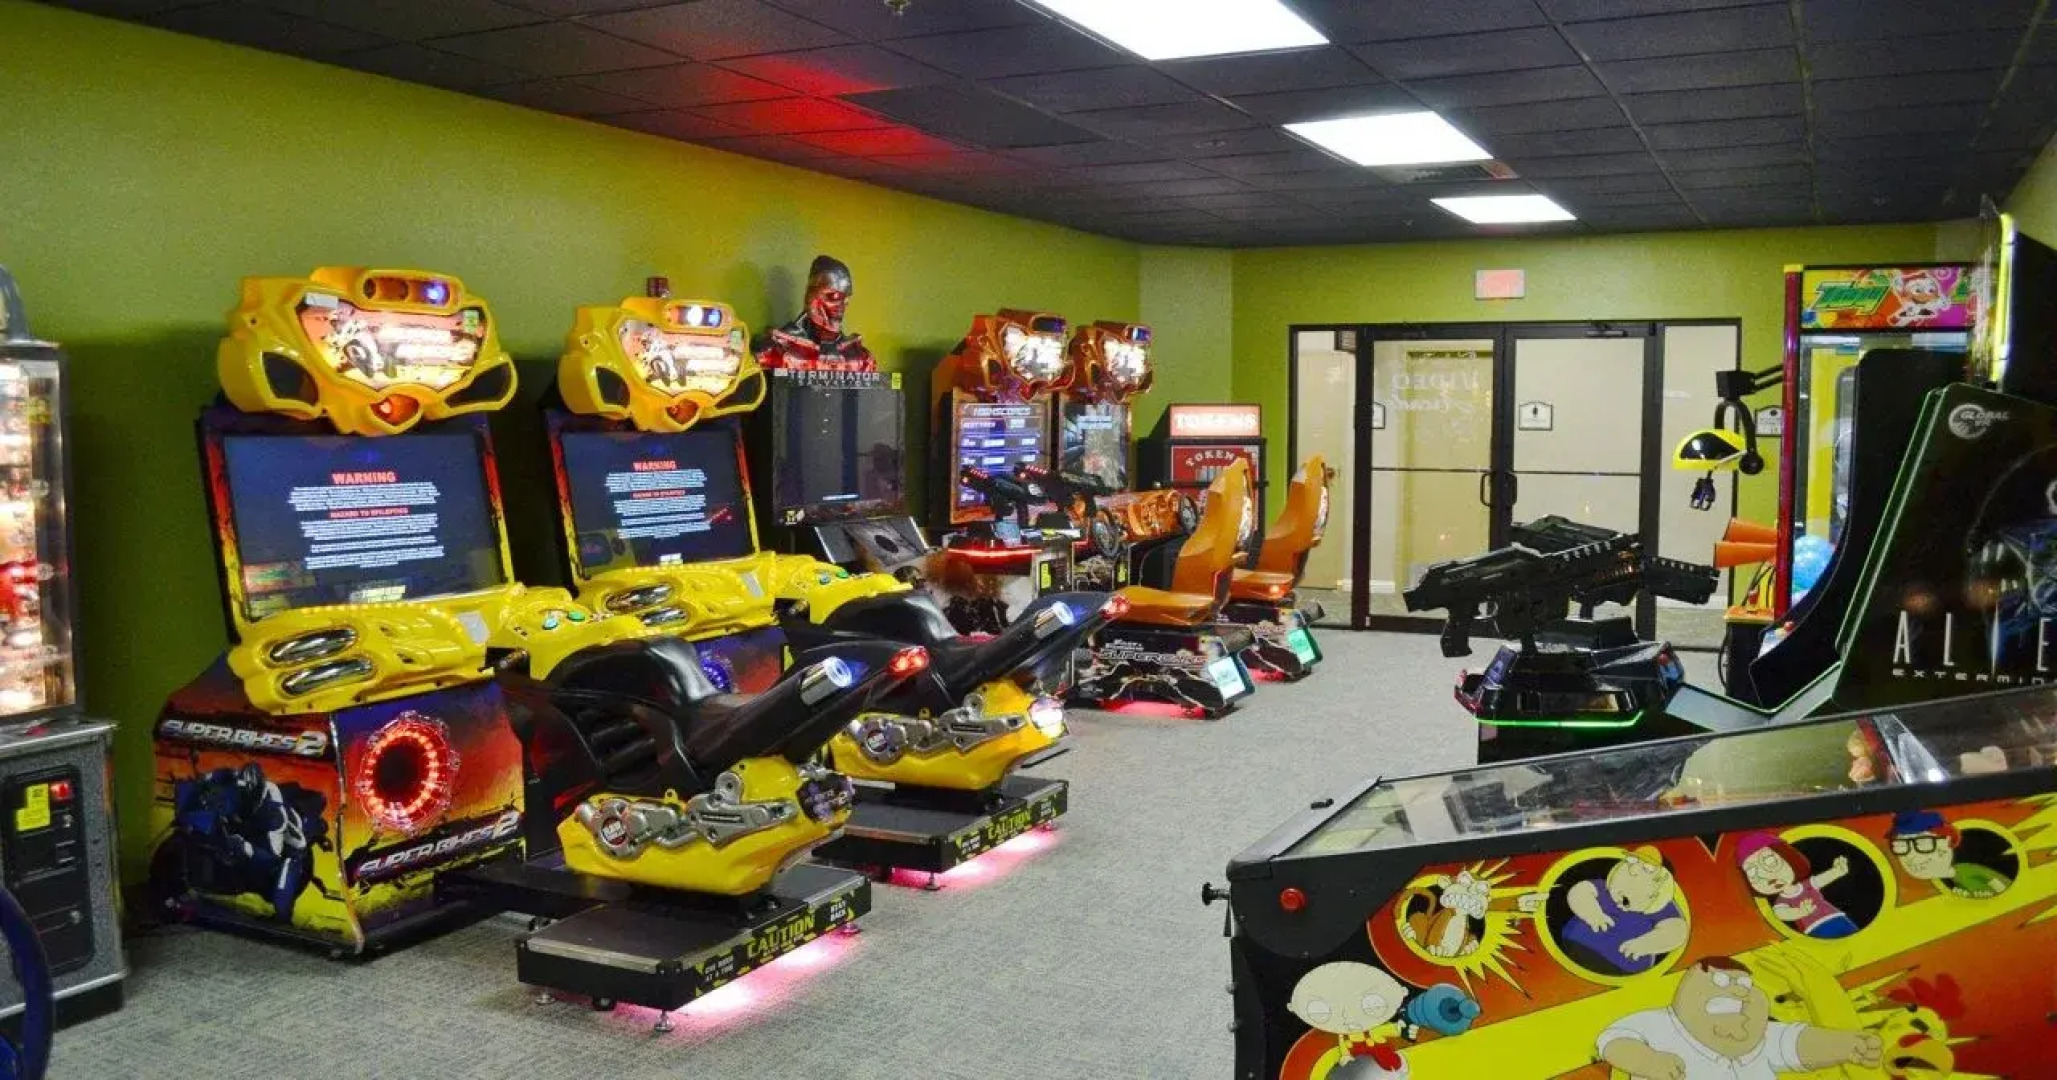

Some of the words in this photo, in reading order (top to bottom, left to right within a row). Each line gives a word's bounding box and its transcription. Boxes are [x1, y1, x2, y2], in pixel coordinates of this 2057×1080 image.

[789, 369, 880, 382] TERMINATOR
[1172, 412, 1257, 431] TOKENS
[1960, 411, 2009, 420] GLOBAL
[632, 460, 677, 471] WARNING
[1185, 450, 1235, 467] TOKEN
[332, 471, 397, 485] WARNING
[1893, 668, 2057, 687] EXTERMIN
[747, 914, 815, 958] CAUTION
